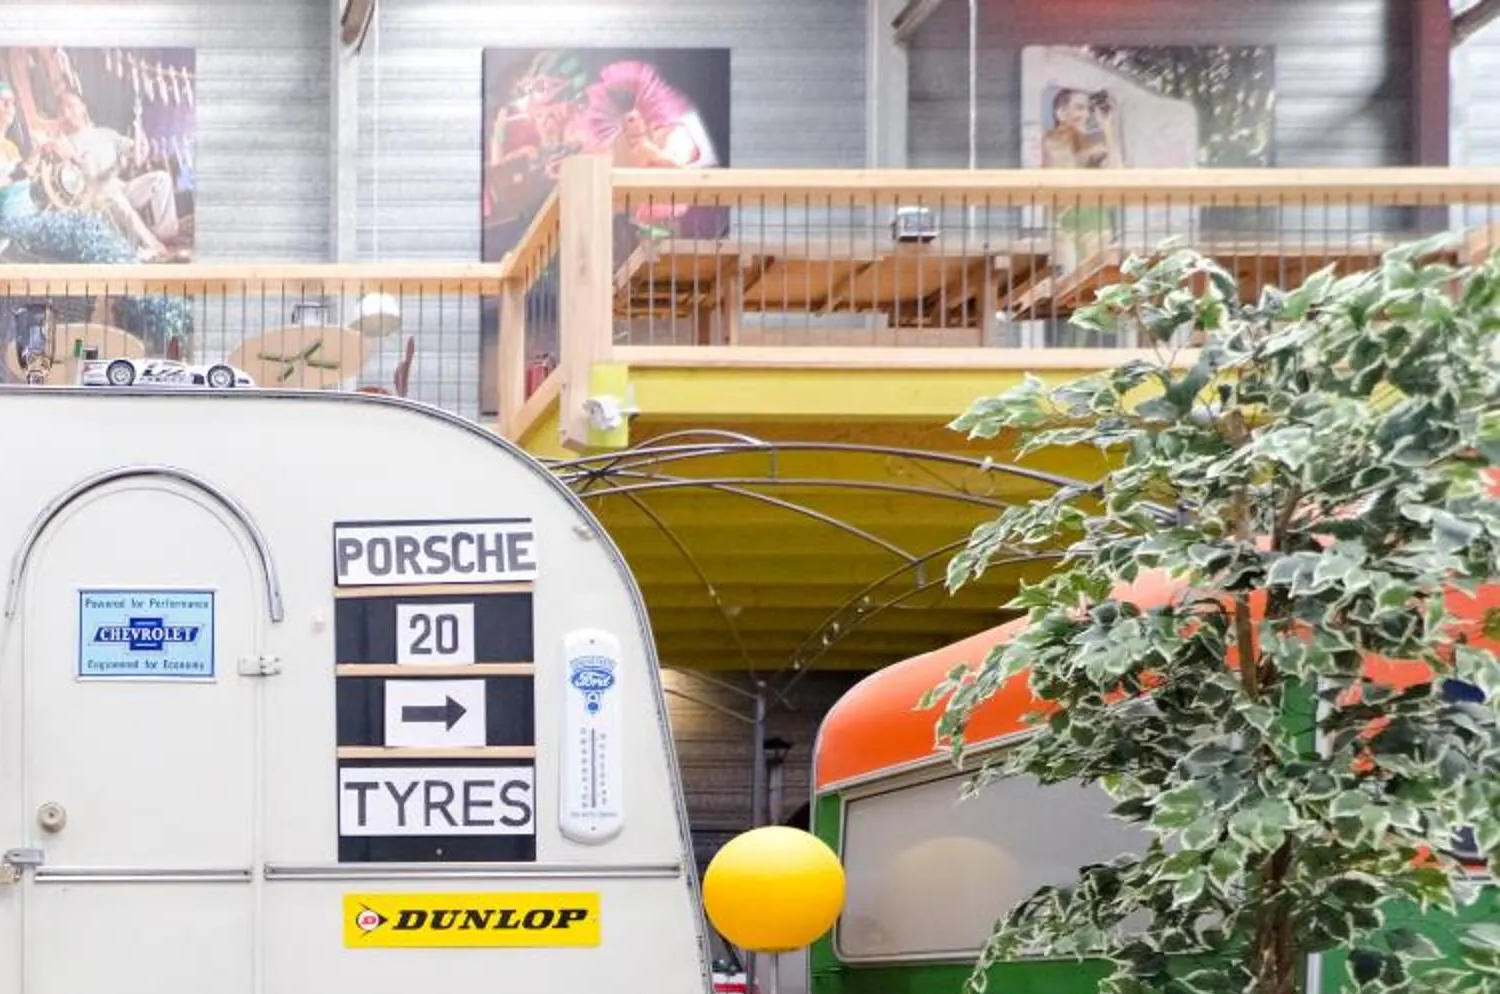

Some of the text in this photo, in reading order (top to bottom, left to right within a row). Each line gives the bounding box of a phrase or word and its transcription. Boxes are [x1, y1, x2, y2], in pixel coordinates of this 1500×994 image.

[337, 532, 537, 577] PORSCHE
[85, 598, 208, 609] Powered for Performance
[100, 627, 192, 641] CHEVROLET
[409, 613, 459, 655] 20
[344, 780, 532, 827] TYRES
[392, 909, 588, 931] DUNLOP
